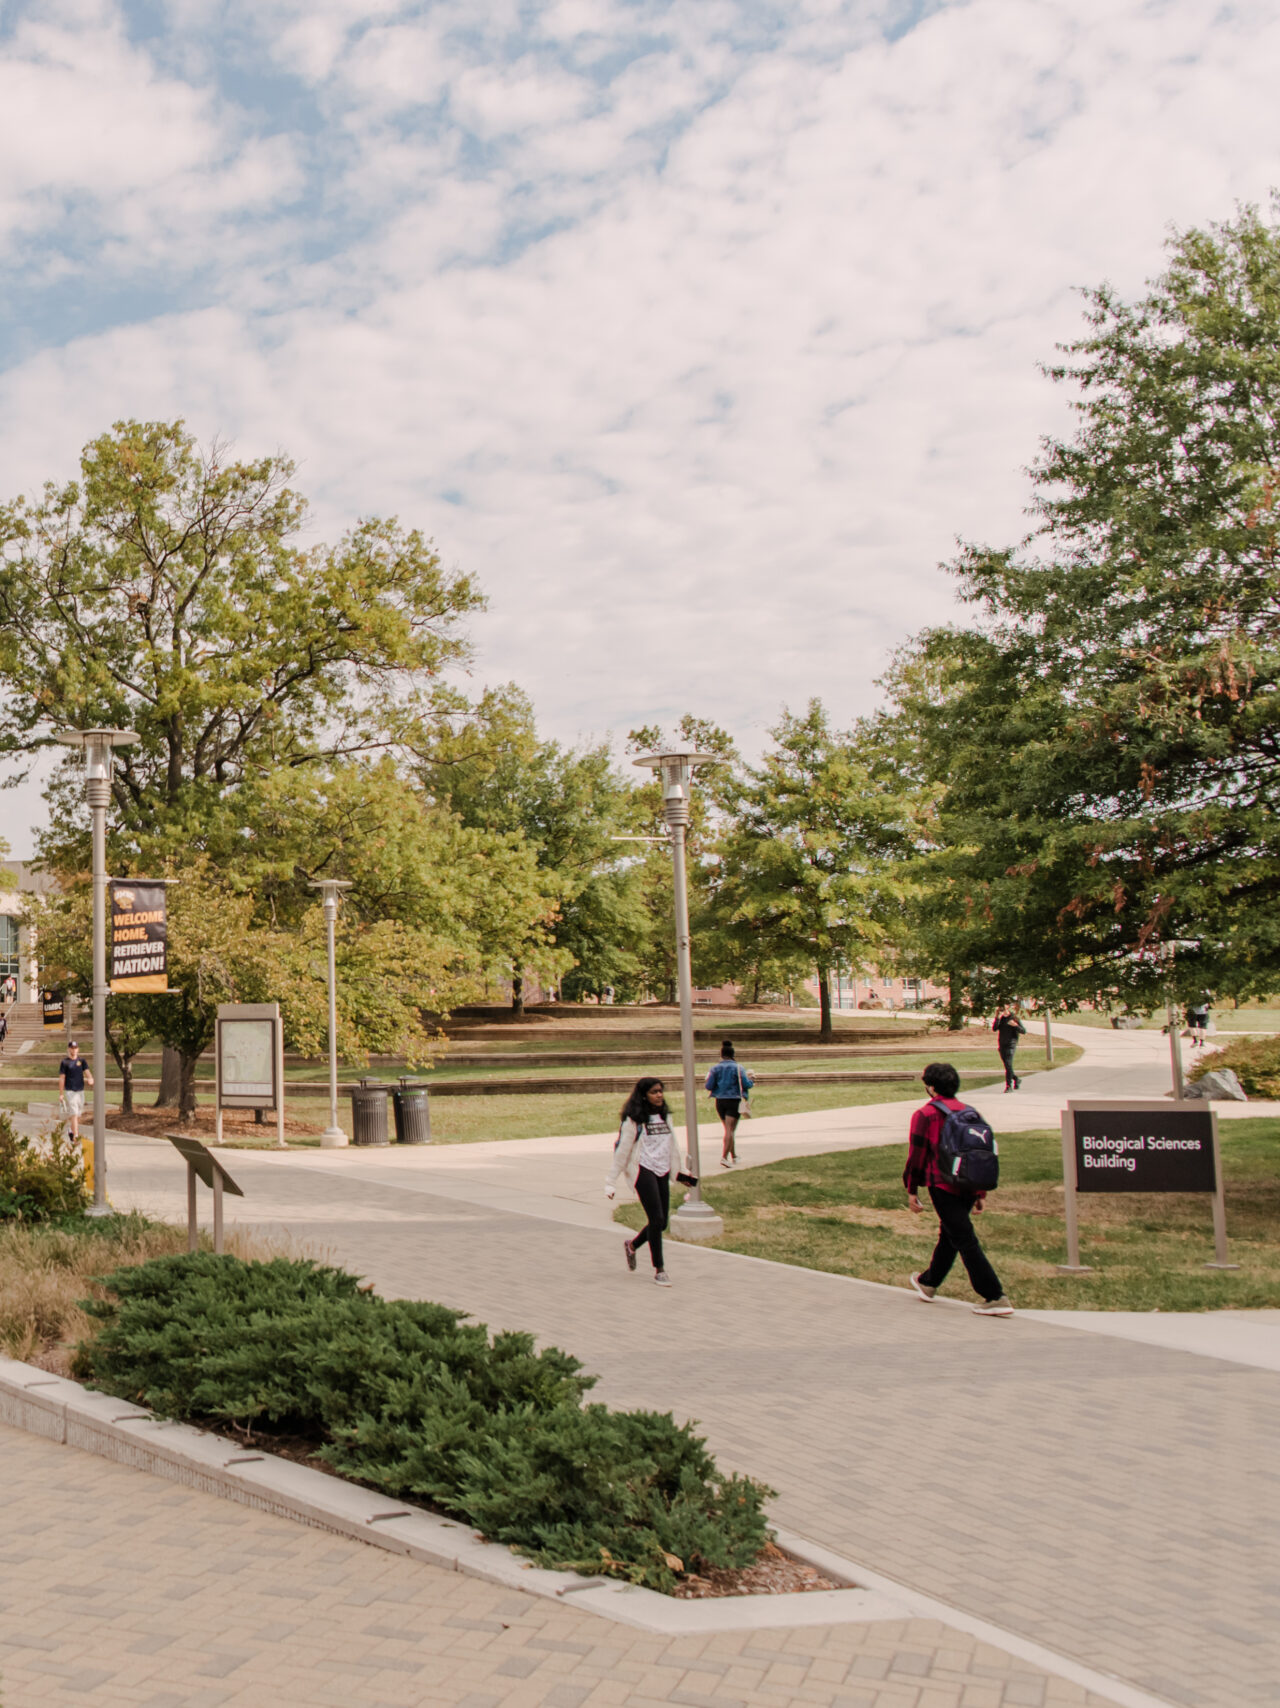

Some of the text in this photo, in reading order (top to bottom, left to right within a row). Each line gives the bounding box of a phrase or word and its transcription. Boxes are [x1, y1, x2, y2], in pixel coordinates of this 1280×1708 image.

[113, 910, 164, 926] WELCOME
[113, 927, 148, 942] HOME,
[114, 941, 164, 957] RETRIEVER
[114, 957, 164, 975] NATION!
[1083, 1136, 1201, 1153] Biological Sciences
[1084, 1154, 1136, 1171] Building
